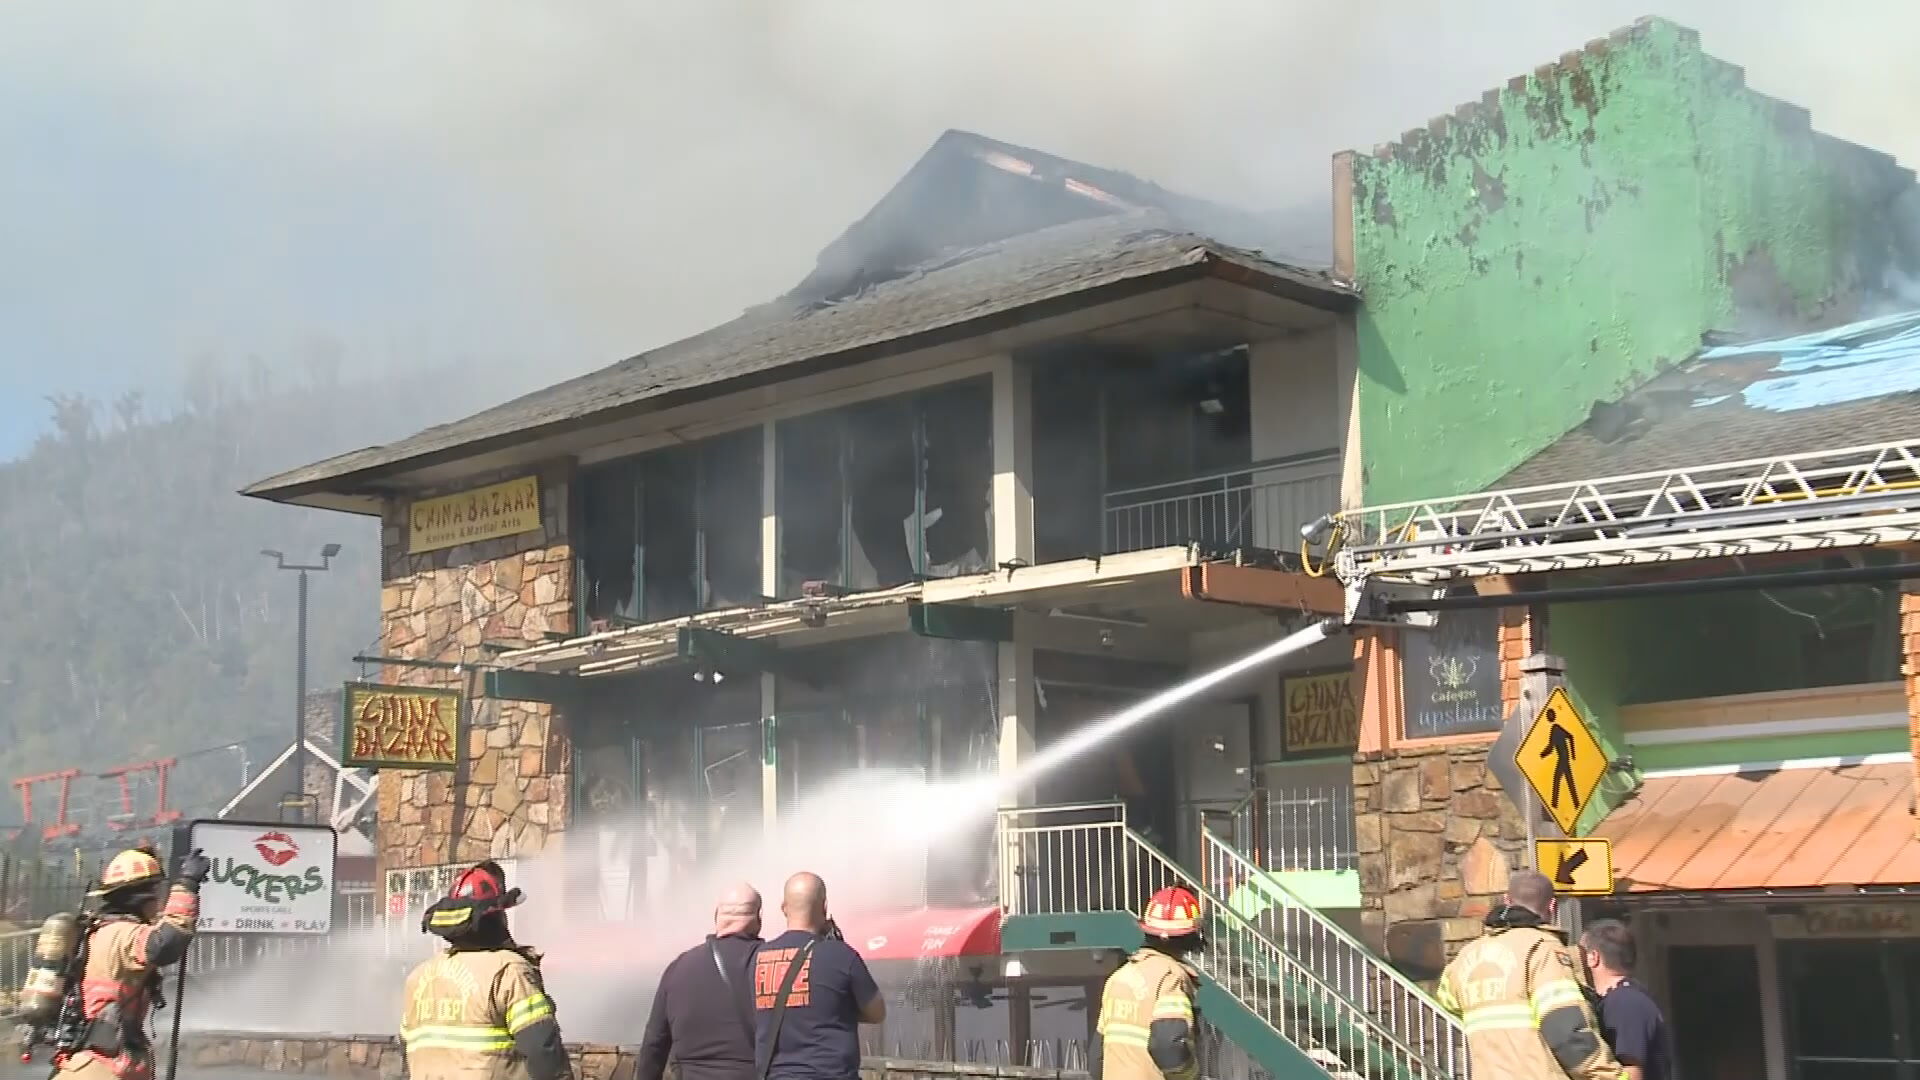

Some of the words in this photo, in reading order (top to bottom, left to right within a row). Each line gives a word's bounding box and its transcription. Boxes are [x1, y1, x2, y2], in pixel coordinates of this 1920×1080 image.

[414, 503, 462, 532] CHINA
[468, 483, 536, 522] BAZAAR
[501, 518, 521, 529] Arts
[359, 694, 448, 729] CHINA
[1288, 677, 1356, 713] CHINA
[1418, 699, 1500, 734] upstairs
[352, 725, 454, 760] BAZAAR
[211, 857, 323, 904] UCKERS
[198, 918, 215, 927] AT
[235, 918, 274, 929] DRINK
[295, 919, 326, 930] PLAY
